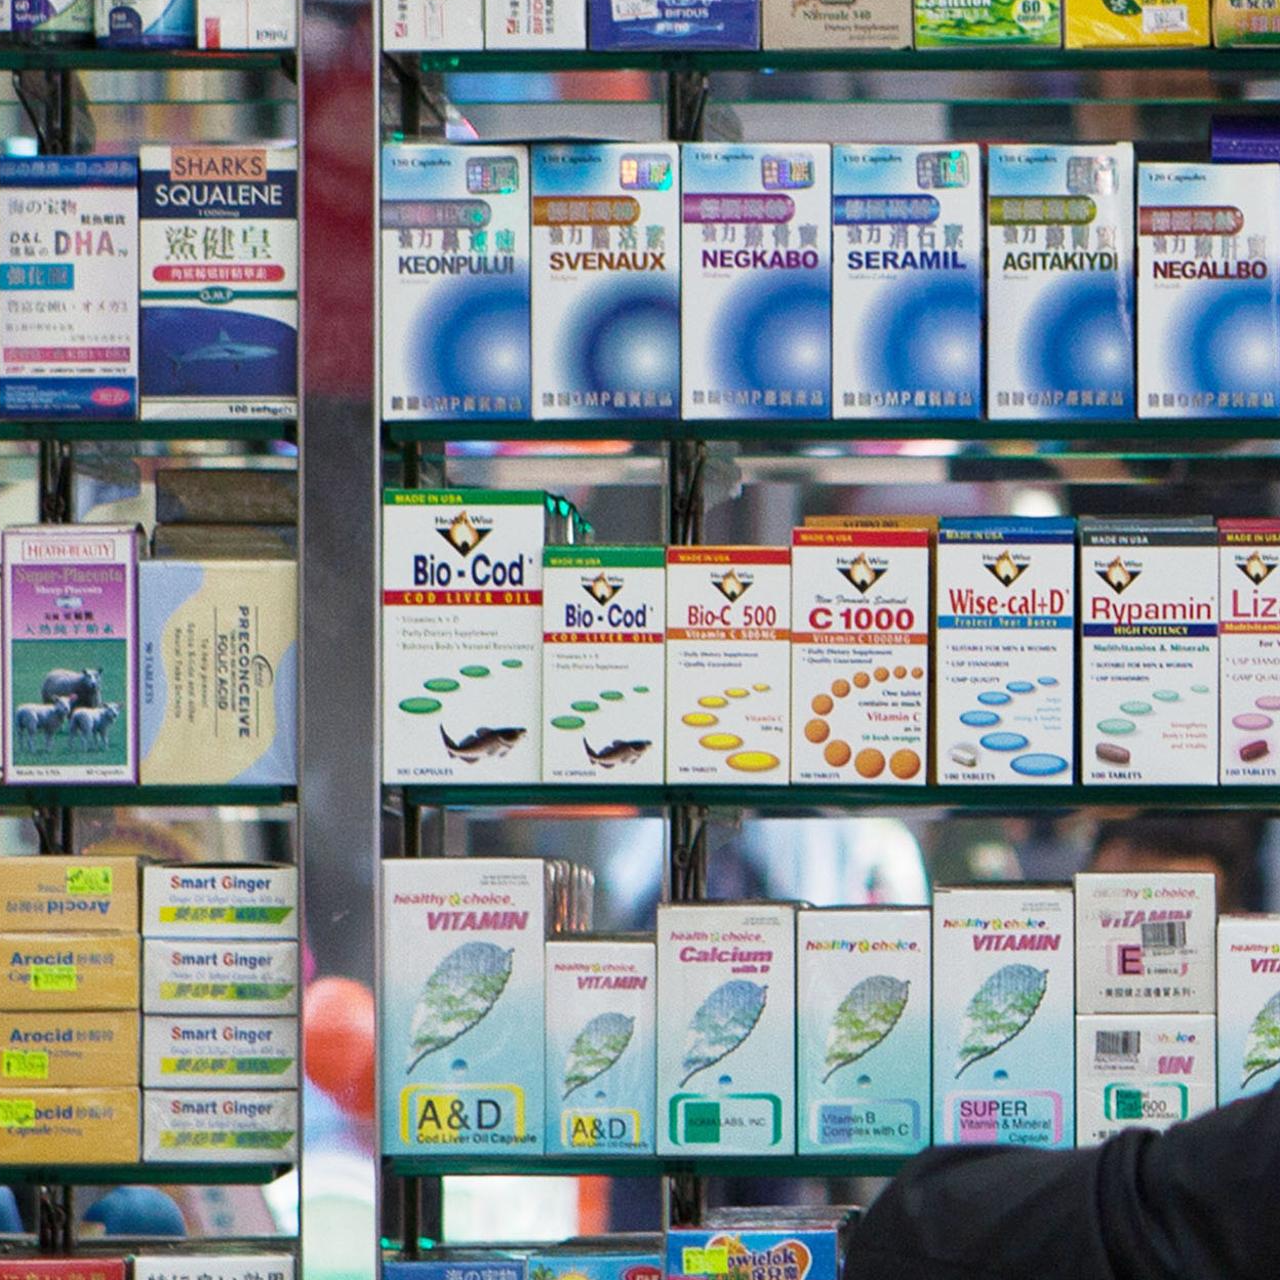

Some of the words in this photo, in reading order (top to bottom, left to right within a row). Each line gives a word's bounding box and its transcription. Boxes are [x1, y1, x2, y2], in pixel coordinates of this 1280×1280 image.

[173, 154, 263, 179] SHARKS
[155, 184, 283, 206] SQUALENE
[53, 228, 116, 258] DHA
[549, 251, 667, 272] SVENAUX
[701, 249, 819, 270] NEGKABO
[847, 249, 968, 271] SERAMIL
[1152, 260, 1268, 280] NEGALLBO
[414, 555, 450, 586] Bio
[472, 554, 524, 586] Cod
[404, 593, 436, 603] COD
[446, 593, 493, 603] LIVER
[504, 593, 531, 603] OIL
[565, 604, 592, 628] Bio
[608, 604, 646, 628] Cod
[688, 605, 733, 626] Bio-C
[743, 606, 777, 626] 500
[809, 608, 835, 630] C
[840, 608, 915, 630] 1000
[1092, 595, 1212, 624] Rypamin
[237, 605, 251, 738] PRECONCEIVE
[170, 875, 215, 892] Smart
[221, 875, 271, 895] Ginger
[427, 911, 528, 931] VITAMIN
[10, 951, 73, 967] Arocid
[170, 952, 215, 968] Smart
[221, 952, 273, 972] Ginger
[577, 975, 647, 991] VITAMIN
[10, 1027, 73, 1044] Arocid
[417, 1098, 503, 1130] A&D
[960, 1100, 1028, 1118] SUPER
[572, 1117, 627, 1139] A&D
